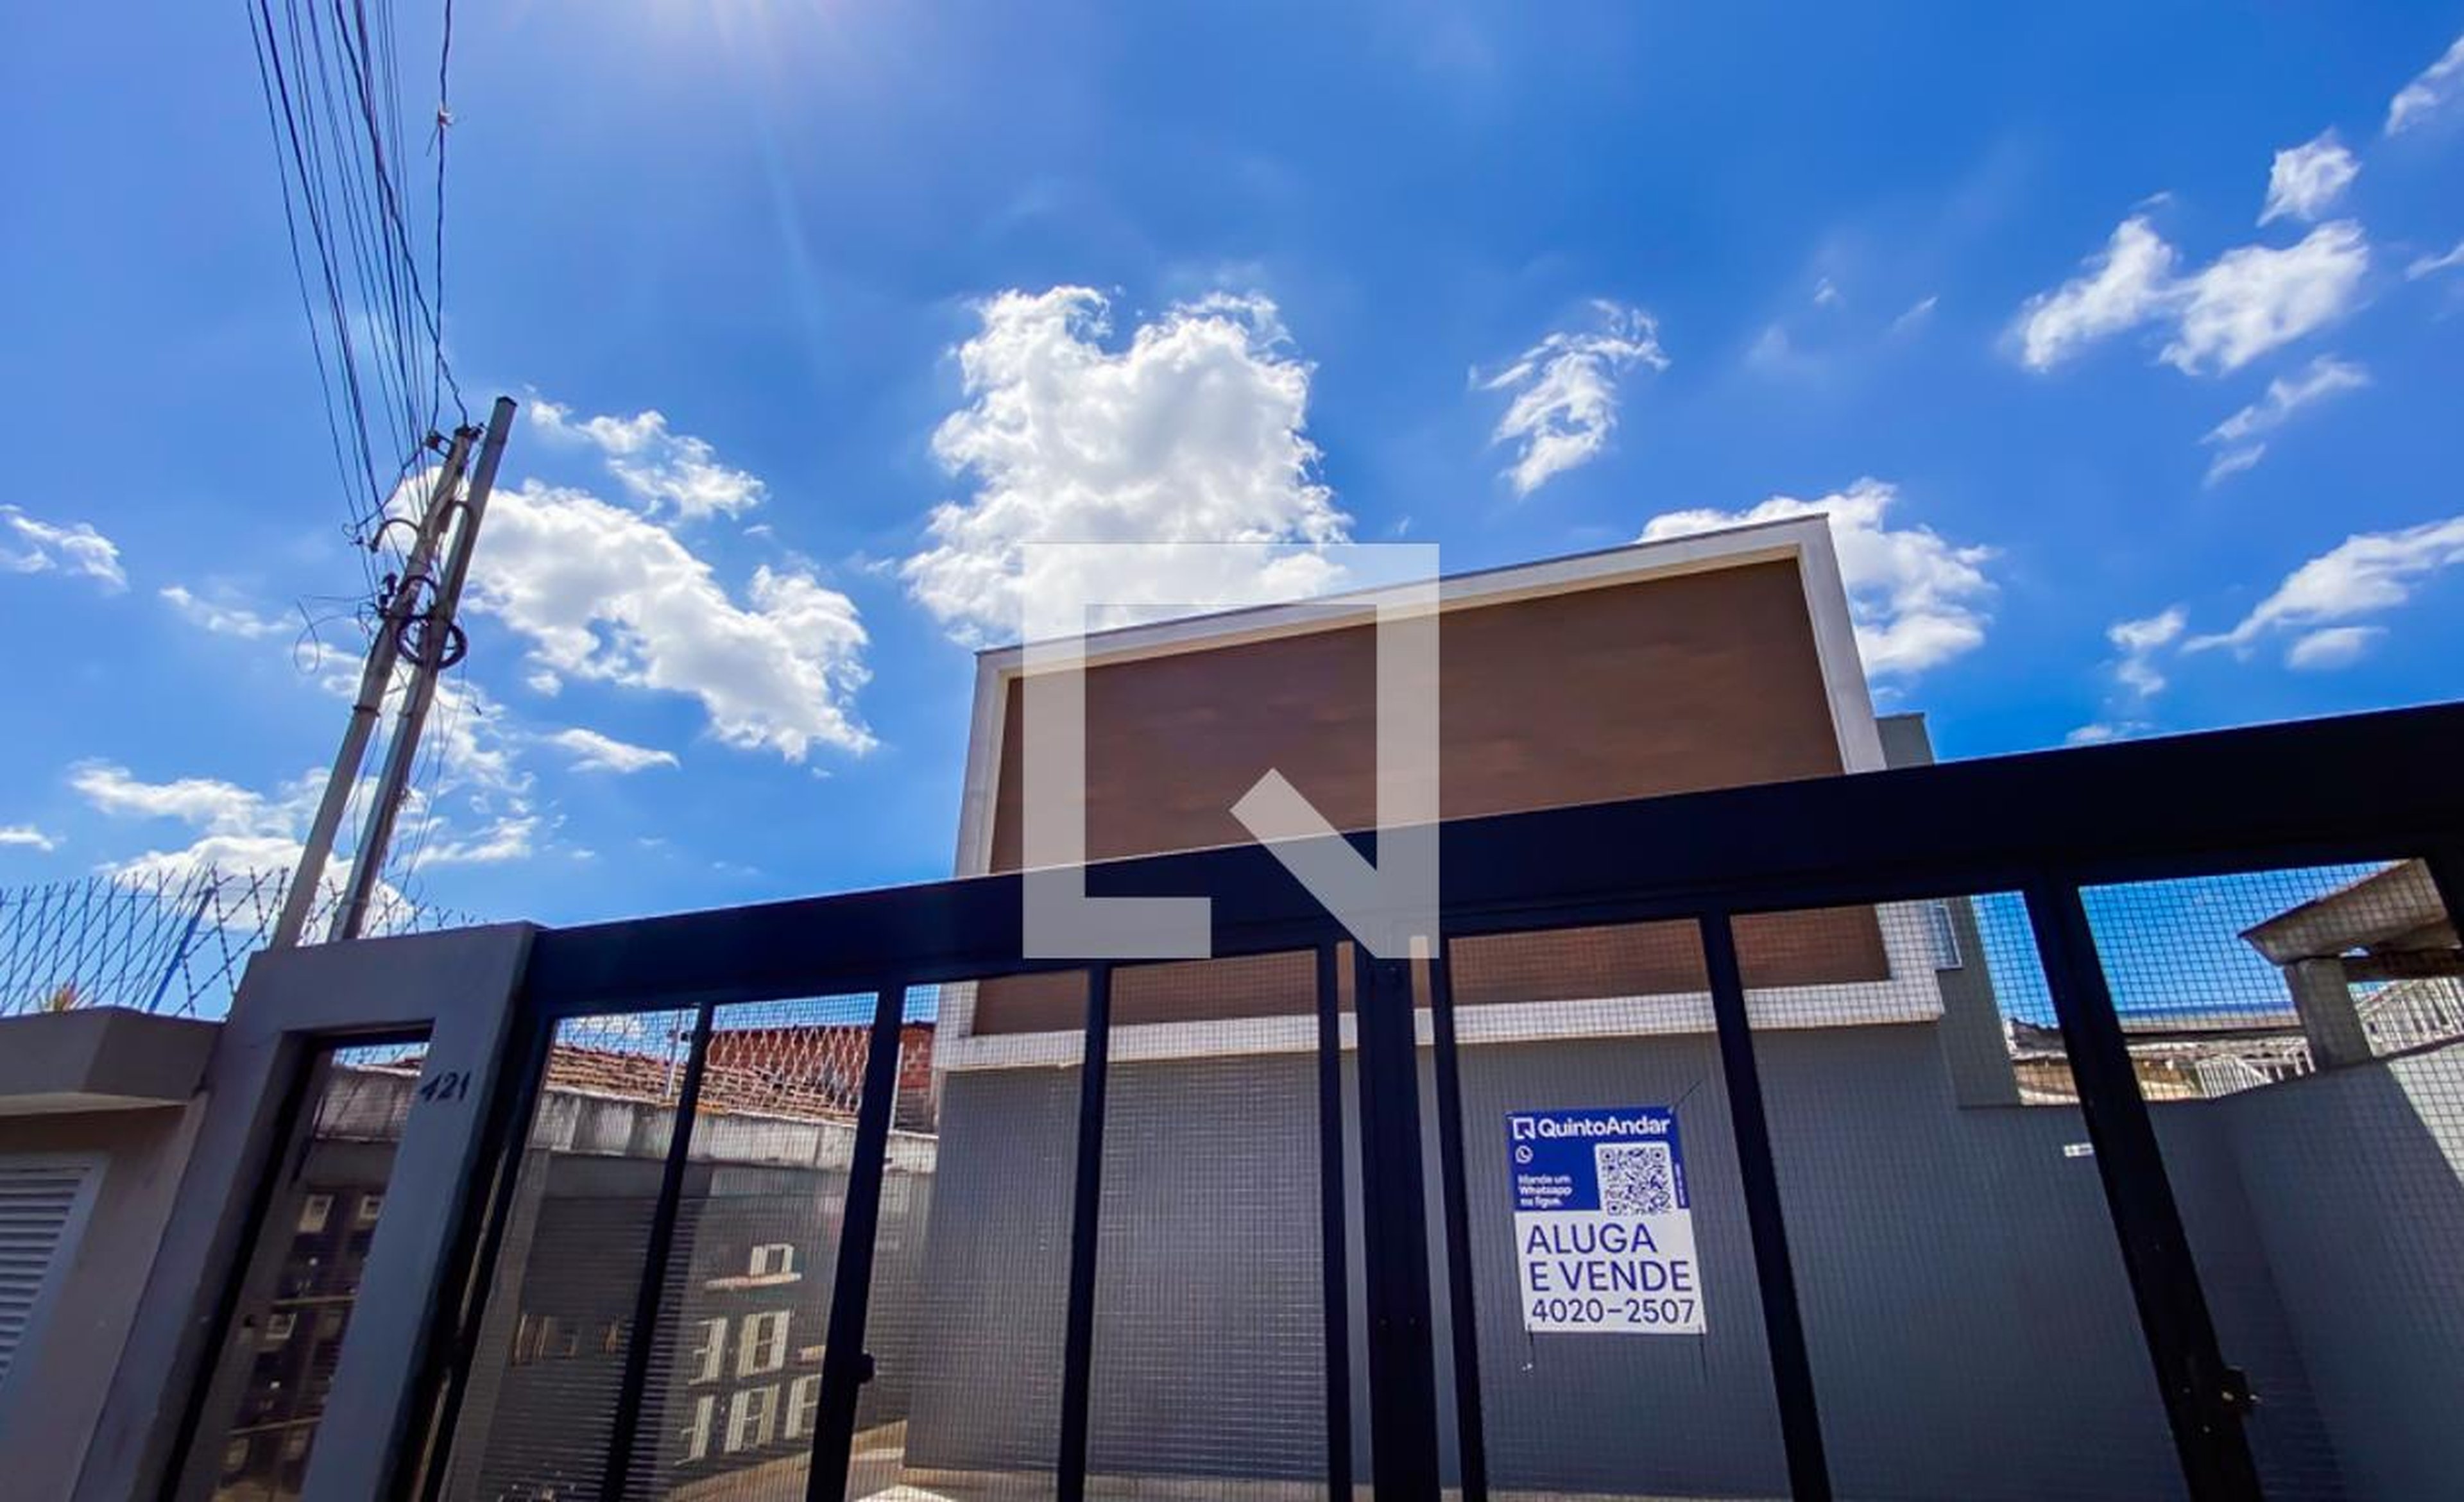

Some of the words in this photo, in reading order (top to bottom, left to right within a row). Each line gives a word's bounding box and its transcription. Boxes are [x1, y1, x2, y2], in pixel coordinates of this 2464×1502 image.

[420, 1071, 470, 1102] 421
[1538, 1116, 1670, 1138] QuintoAndar
[1527, 1224, 1657, 1254] ALUGA
[1530, 1261, 1550, 1291] E
[1559, 1261, 1693, 1292] VENDE
[1532, 1299, 1695, 1323] 4020-2507
